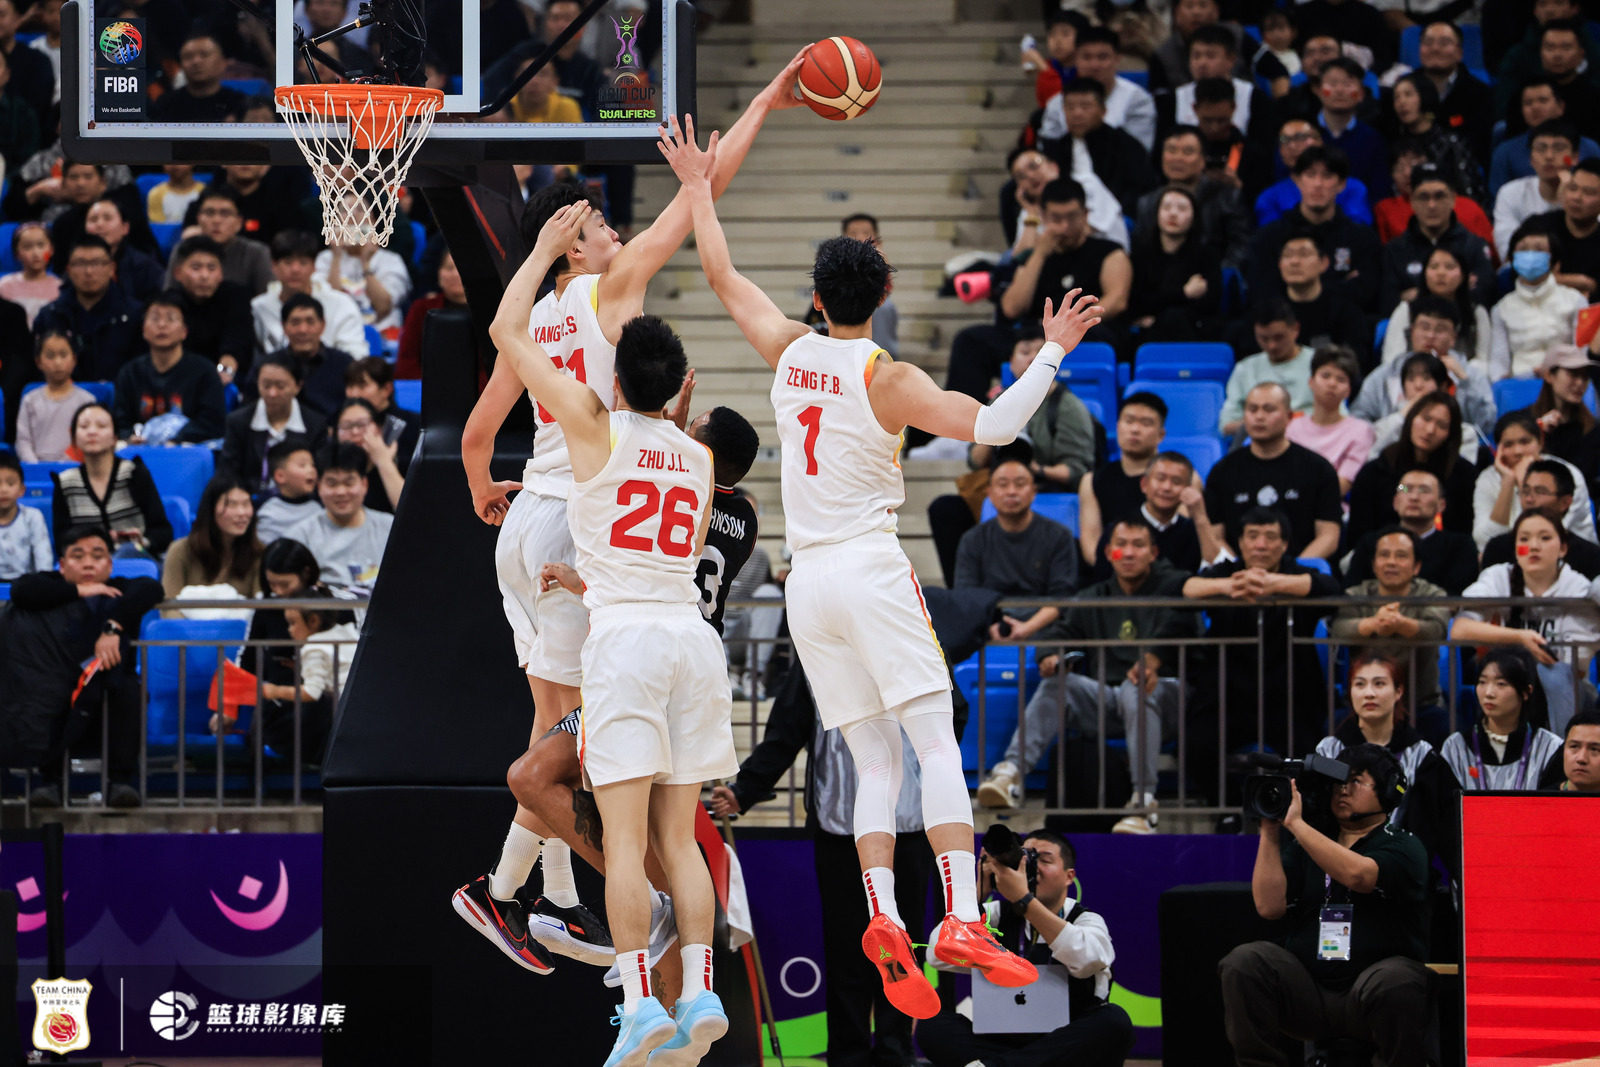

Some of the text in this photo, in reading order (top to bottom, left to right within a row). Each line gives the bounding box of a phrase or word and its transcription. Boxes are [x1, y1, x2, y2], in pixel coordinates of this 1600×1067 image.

[104, 76, 138, 93] FIBA
[631, 87, 656, 101] CUP
[599, 109, 657, 119] QUALIFIERS
[534, 315, 578, 344] YANG .S
[786, 366, 844, 396] ZENG F.B.
[796, 405, 824, 476] 1
[637, 448, 690, 473] ZHU J.L.
[609, 479, 699, 558] 26
[710, 506, 746, 541] HNSON
